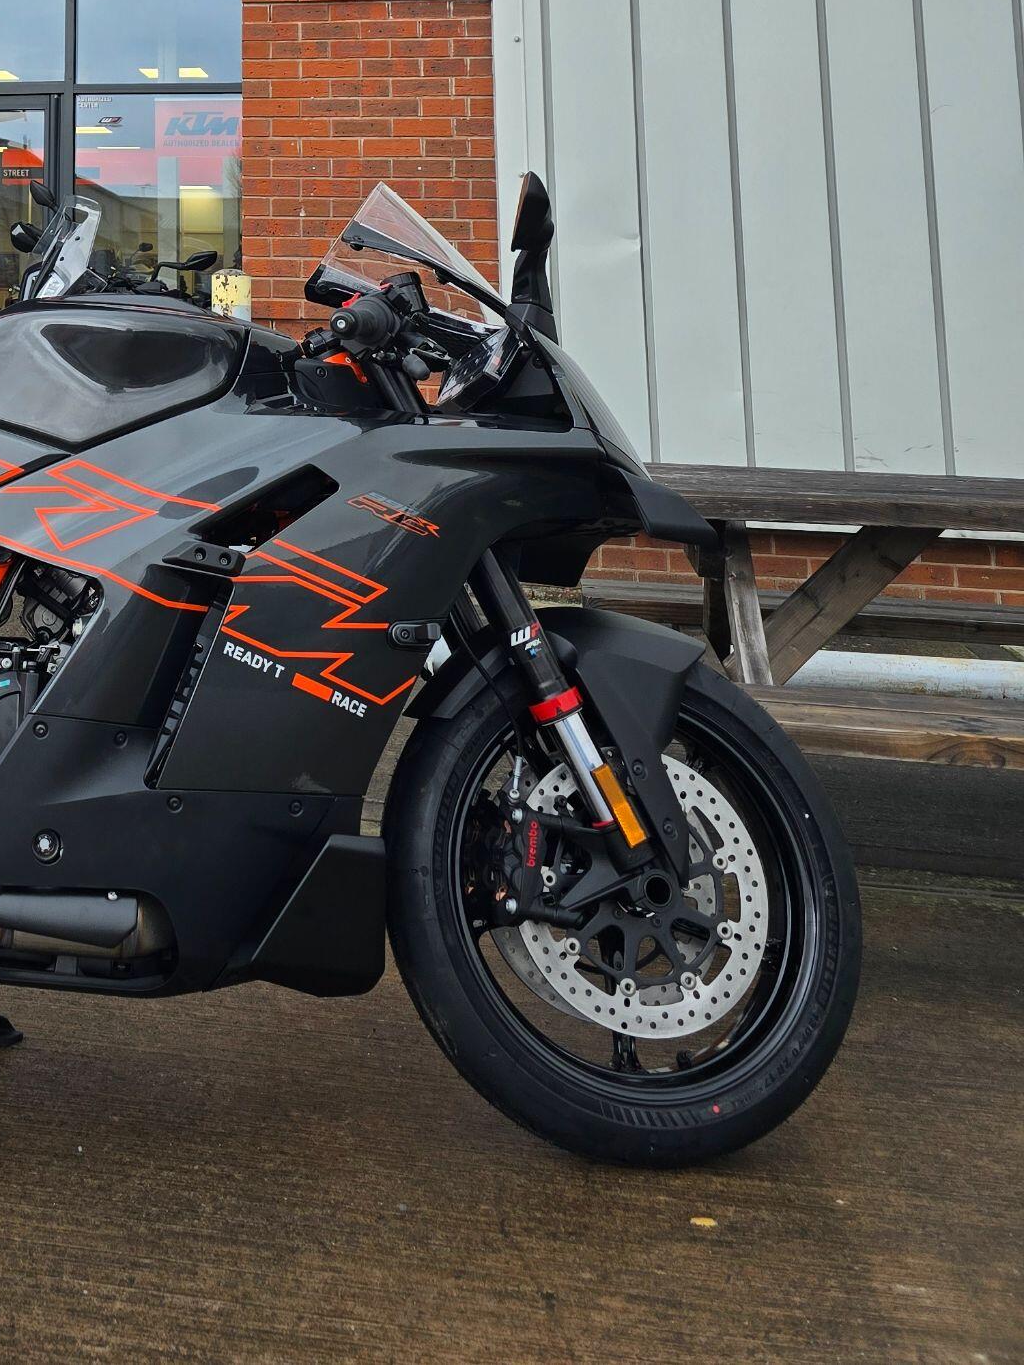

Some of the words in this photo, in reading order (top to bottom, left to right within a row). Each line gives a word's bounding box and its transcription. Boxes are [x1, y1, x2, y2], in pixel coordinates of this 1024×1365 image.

[164, 111, 240, 136] KTM
[3, 169, 29, 177] STREET
[223, 641, 274, 673] READY
[275, 663, 286, 678] T
[331, 691, 368, 718] RACE
[526, 820, 538, 867] brembo
